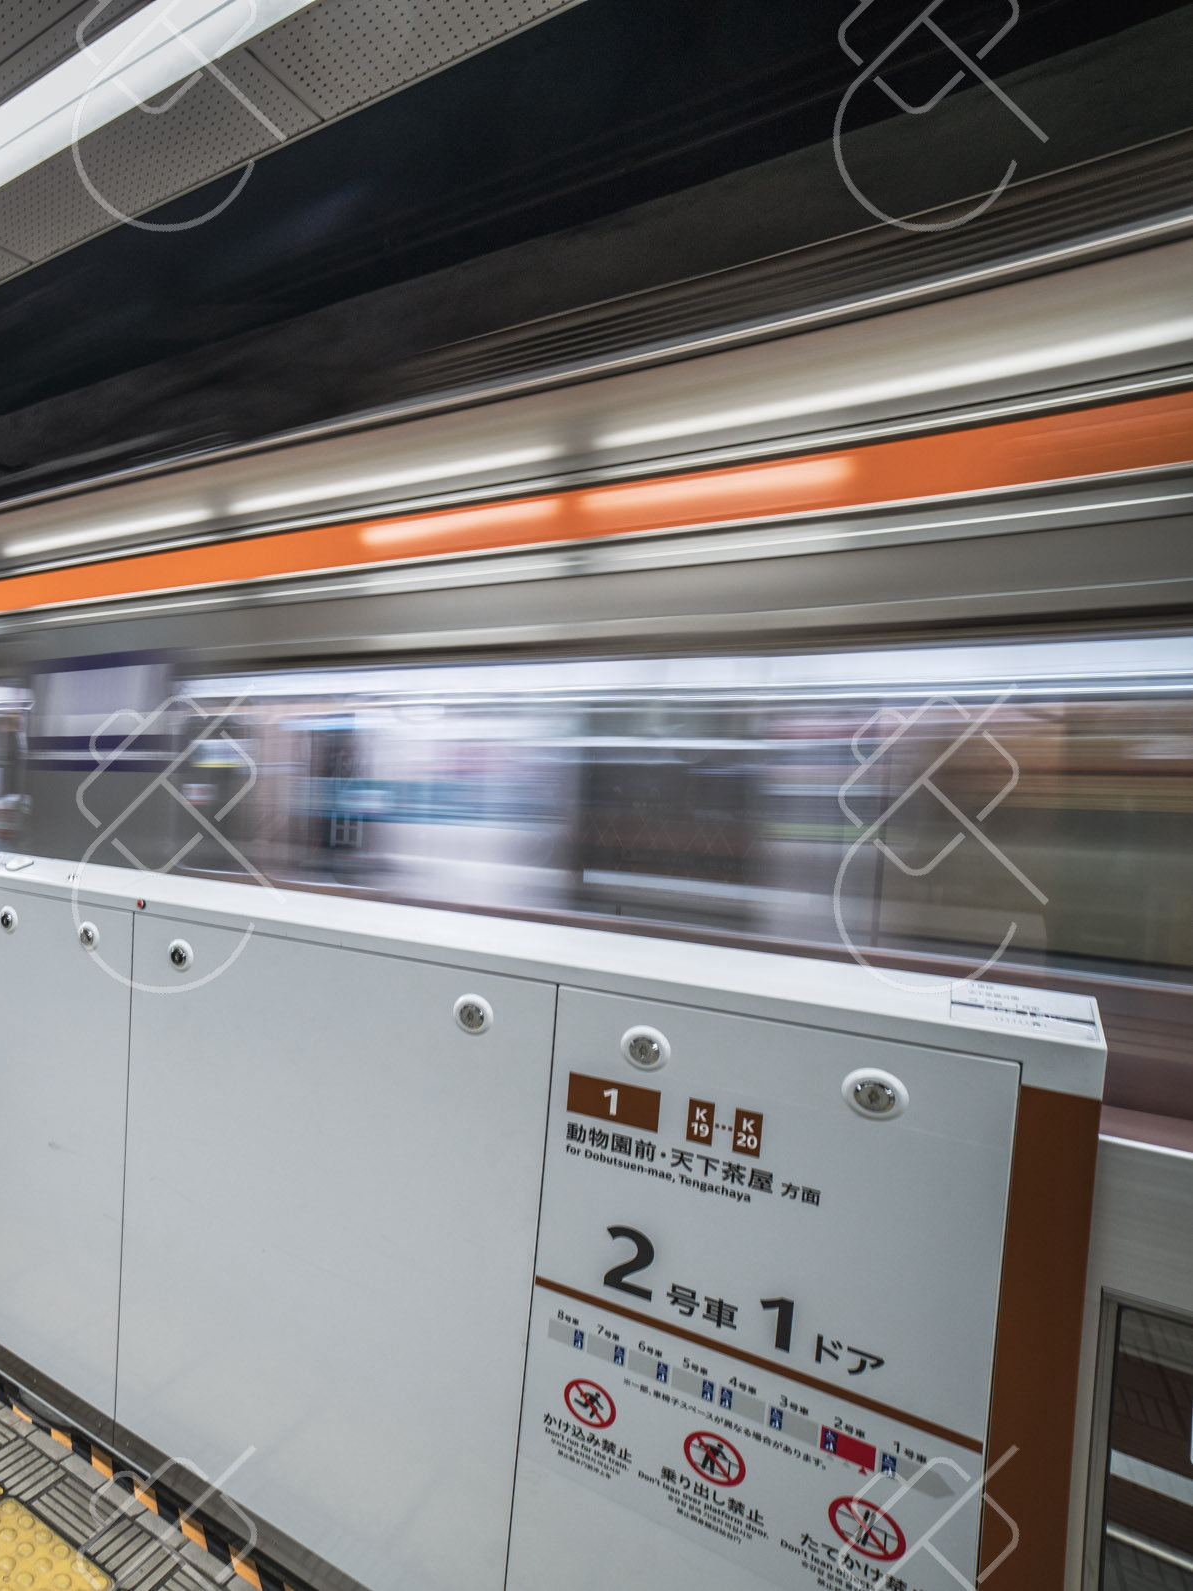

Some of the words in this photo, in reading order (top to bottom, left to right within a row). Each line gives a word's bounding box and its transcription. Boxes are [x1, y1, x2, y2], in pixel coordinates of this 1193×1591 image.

[603, 1087, 619, 1116] 1
[691, 1121, 710, 1138] 19
[736, 1132, 758, 1150] 20
[566, 1144, 581, 1156] for
[585, 1148, 676, 1183] Dobutsuen-mae,
[678, 1173, 752, 1203] Tengachaya
[781, 1182, 821, 1207] 方面
[543, 1412, 632, 1464] かけ込み禁止
[545, 1426, 565, 1440] Don't
[567, 1437, 579, 1448] run
[581, 1443, 591, 1453] for
[594, 1449, 606, 1460] the
[638, 1470, 660, 1486] Don't
[663, 1481, 680, 1495] lean
[683, 1493, 701, 1505] over
[704, 1502, 743, 1527] platform
[661, 1466, 764, 1527] 乗り出し禁止
[780, 1538, 807, 1558] Don't
[811, 1552, 833, 1571] lean
[801, 1533, 924, 1591] たてかけ禁
